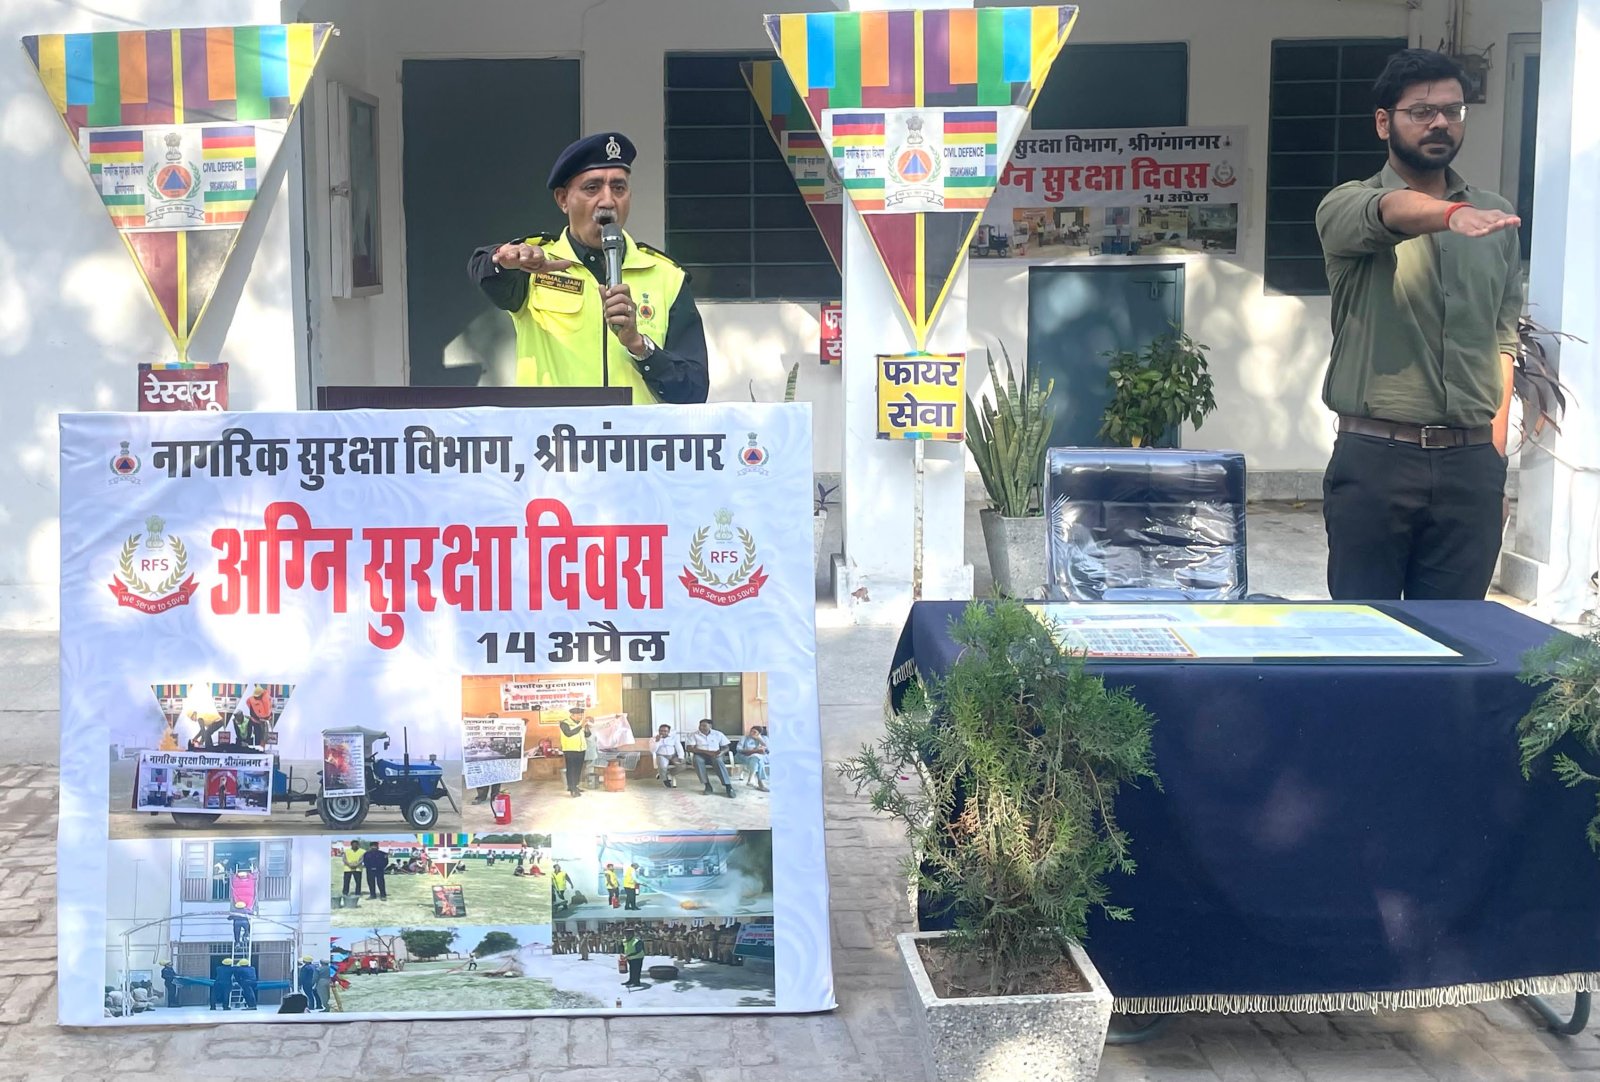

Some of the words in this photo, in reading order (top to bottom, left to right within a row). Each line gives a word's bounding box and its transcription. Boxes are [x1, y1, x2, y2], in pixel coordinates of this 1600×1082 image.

[1128, 131, 1221, 151] श्रीगंगानगर
[944, 147, 957, 158] CIVIL
[958, 147, 984, 158] DEFENCE
[203, 162, 216, 172] CIVIL
[217, 161, 243, 172] DEFENCE
[1041, 166, 1126, 203] सुरक्षा
[1131, 157, 1210, 190] दिवस
[1144, 193, 1164, 203] 14
[537, 273, 562, 283] NIRMAL
[565, 279, 581, 287] JAIN
[883, 361, 960, 386] फायर
[887, 392, 956, 427] सेवा
[151, 427, 290, 477] नागरिक
[297, 437, 398, 491] सुरक्षा
[404, 425, 525, 482] विभाग,
[534, 422, 726, 472] श्रीगंगानगर
[710, 551, 738, 563] RFS
[141, 559, 169, 571] RFS
[210, 501, 353, 615] अग्नि
[362, 524, 517, 650] सुरक्षा
[525, 498, 668, 611] दिवस
[737, 586, 755, 599] save
[167, 594, 185, 608] save
[476, 631, 536, 663] 14
[548, 621, 669, 664] अप्रैल
[149, 753, 177, 764] नागरिक
